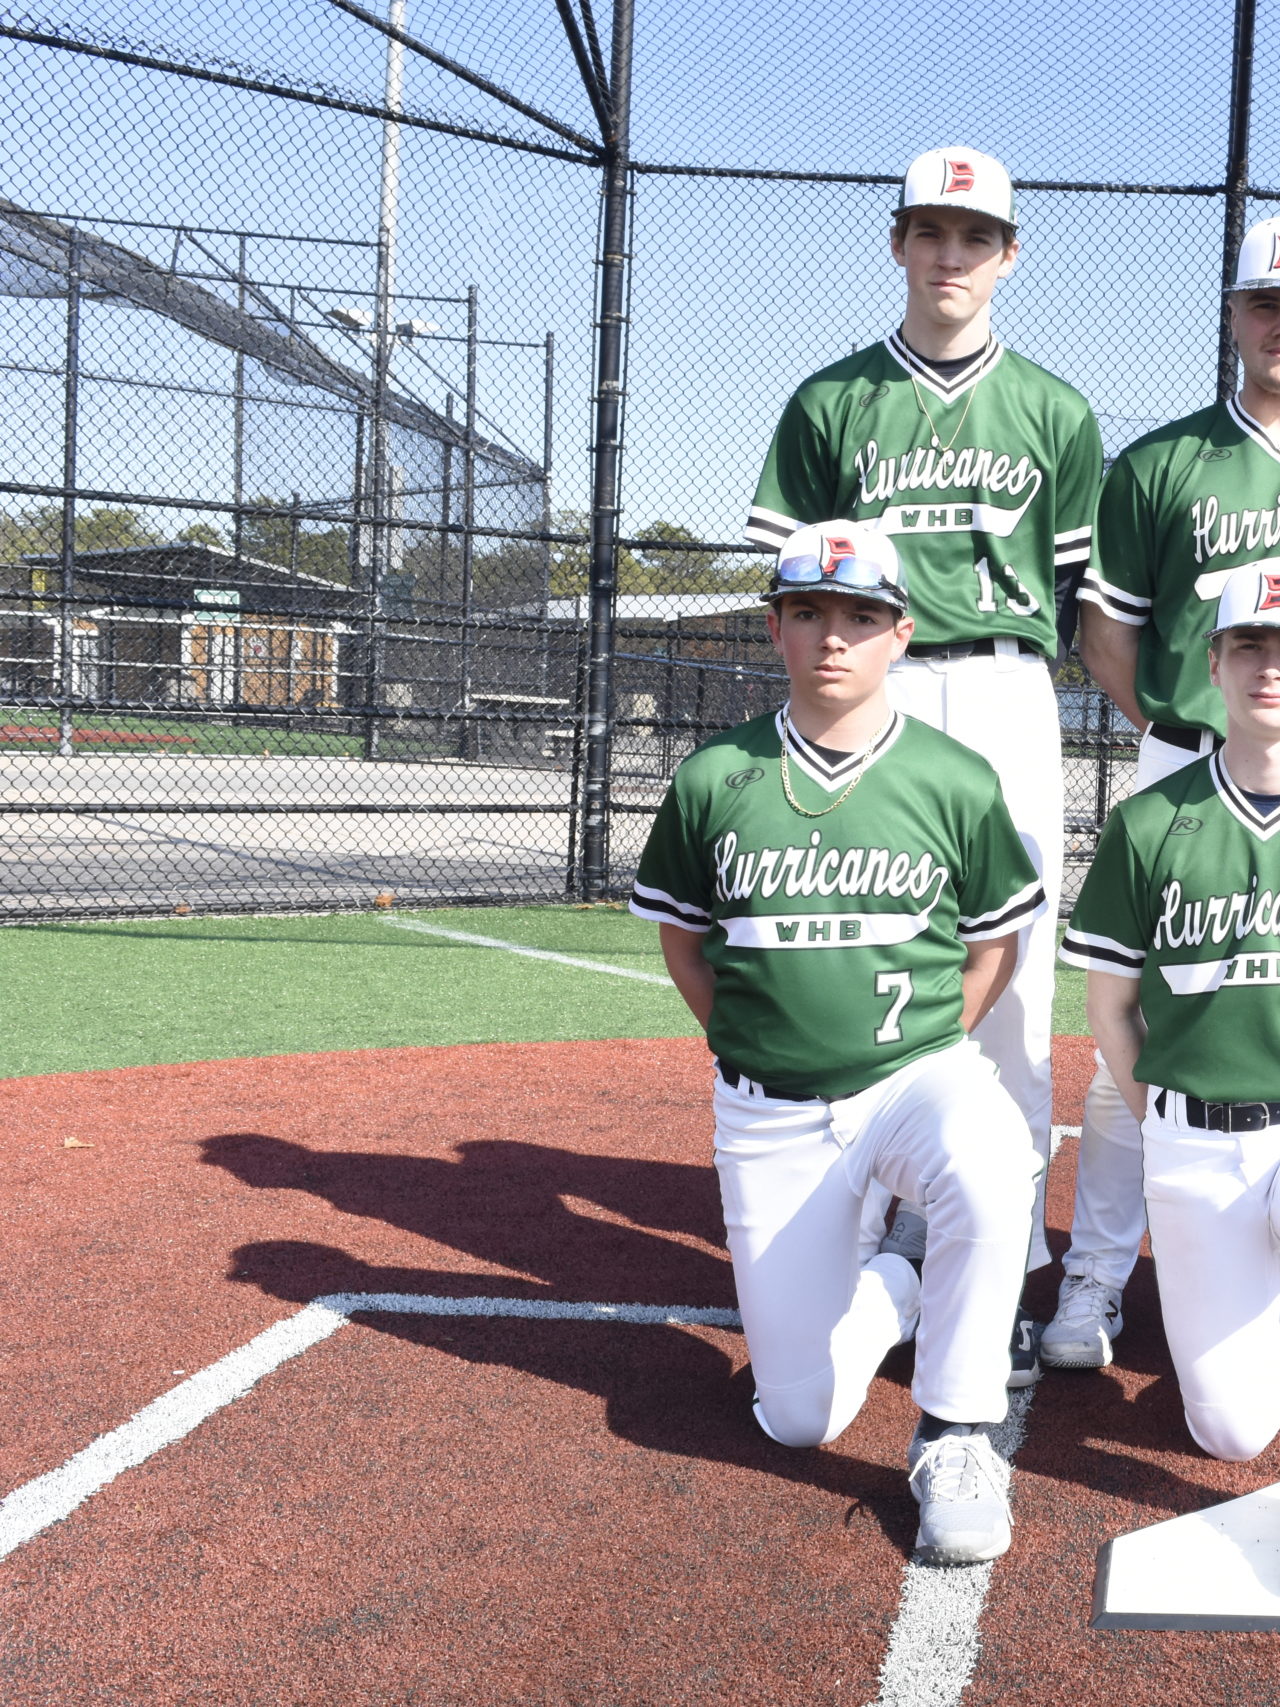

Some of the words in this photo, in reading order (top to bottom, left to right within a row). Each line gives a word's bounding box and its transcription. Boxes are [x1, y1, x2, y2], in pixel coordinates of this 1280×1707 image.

[853, 434, 1042, 508] Hurricanes
[901, 508, 973, 528] WHB
[714, 829, 949, 902] Hurricanes
[775, 920, 862, 943] WHB
[874, 969, 914, 1046] 7
